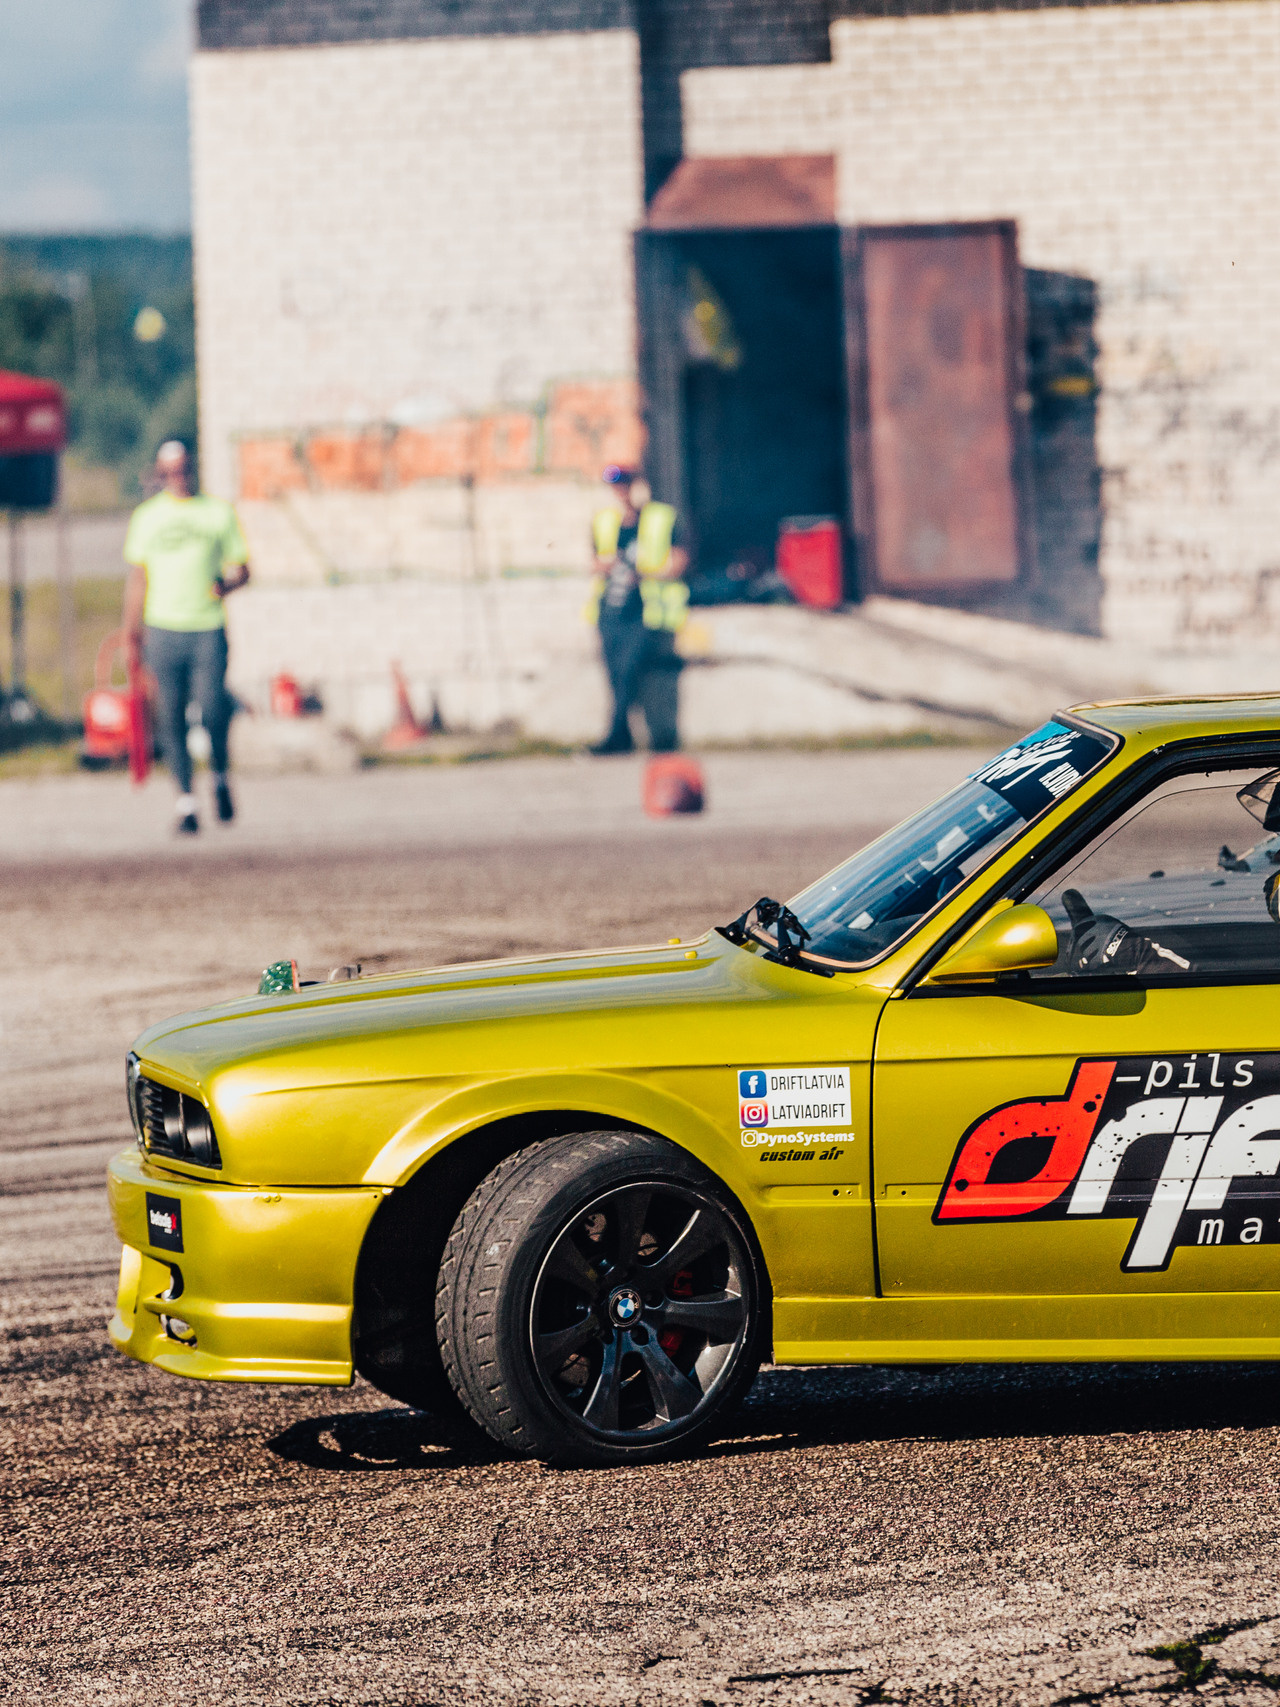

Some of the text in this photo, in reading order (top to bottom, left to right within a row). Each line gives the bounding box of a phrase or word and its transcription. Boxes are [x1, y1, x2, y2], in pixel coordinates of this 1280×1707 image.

[771, 1074, 845, 1091] DRIFTLATVIA
[772, 1103, 846, 1119] LATVIADRIFT
[758, 1131, 855, 1147] DynoSystems
[760, 1146, 844, 1162] custom air
